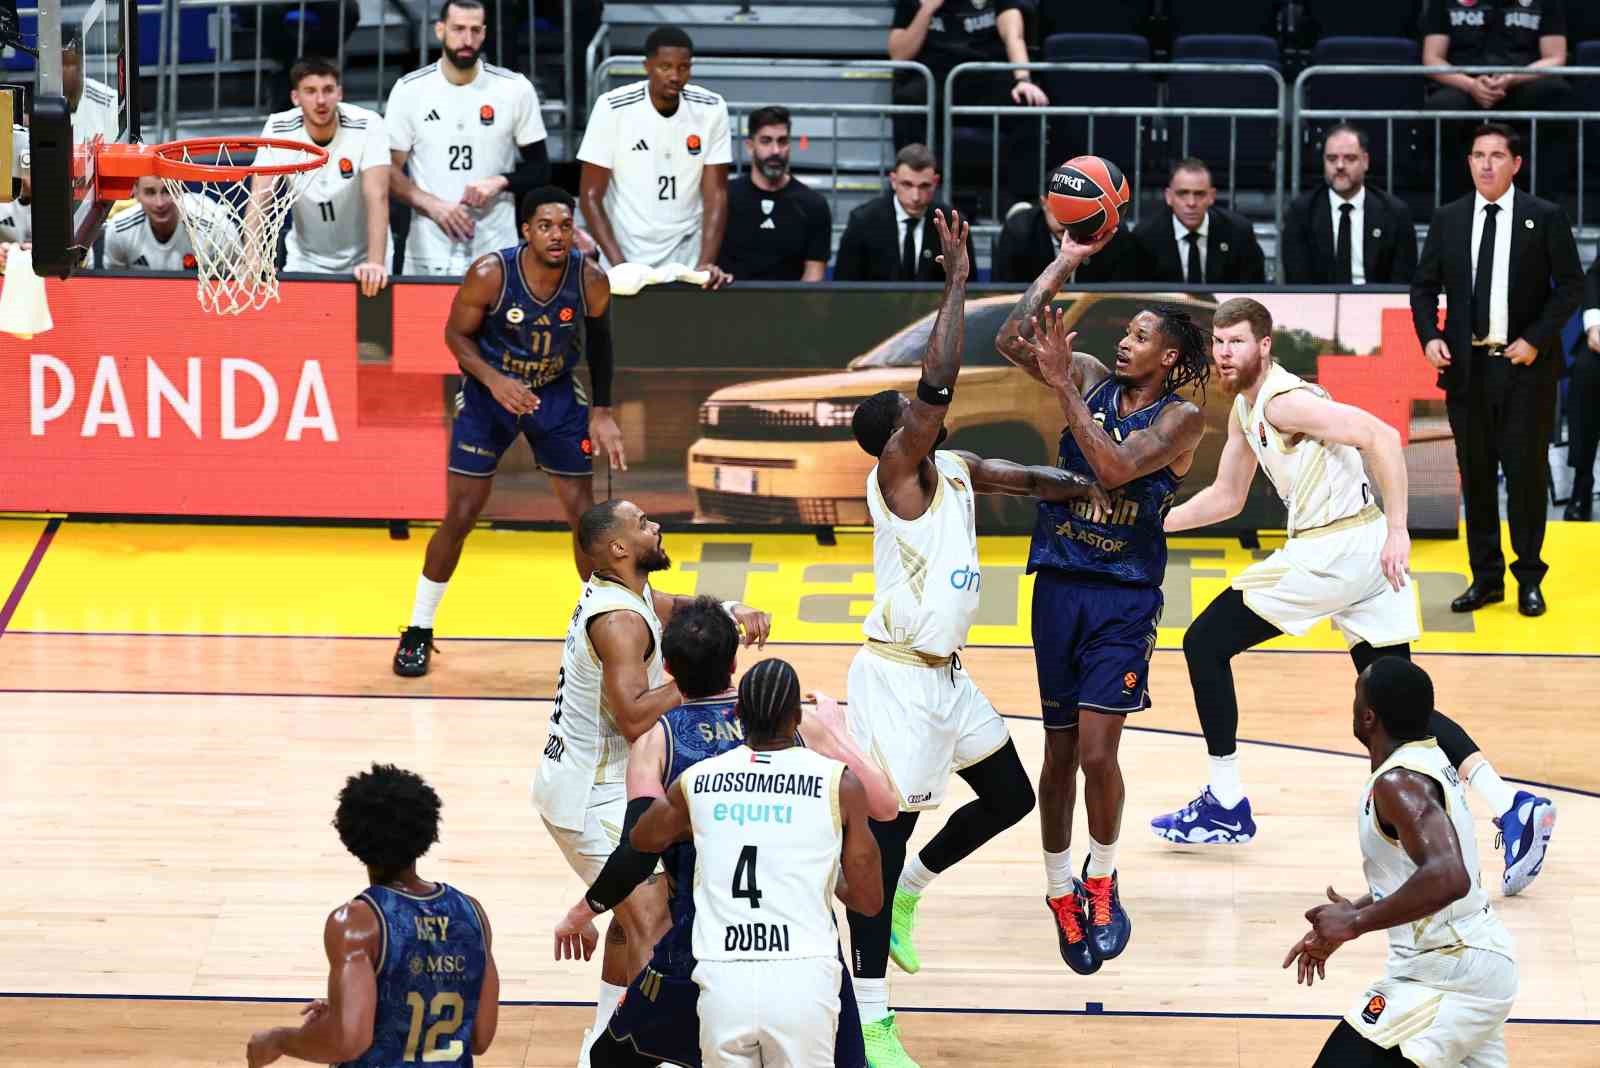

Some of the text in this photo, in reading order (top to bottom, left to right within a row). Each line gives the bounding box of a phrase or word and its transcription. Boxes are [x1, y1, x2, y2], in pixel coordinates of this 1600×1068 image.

[448, 145, 472, 170] 23
[658, 175, 676, 200] 21
[317, 200, 336, 222] 11
[531, 331, 552, 355] 11
[29, 353, 339, 442] PANDA
[693, 772, 824, 799] BLOSSOMGAME
[713, 803, 793, 827] equiti
[731, 845, 763, 909] 4
[414, 915, 449, 941] KEY
[724, 923, 790, 952] DUBAI
[427, 955, 466, 973] MSC
[403, 991, 464, 1063] 12
